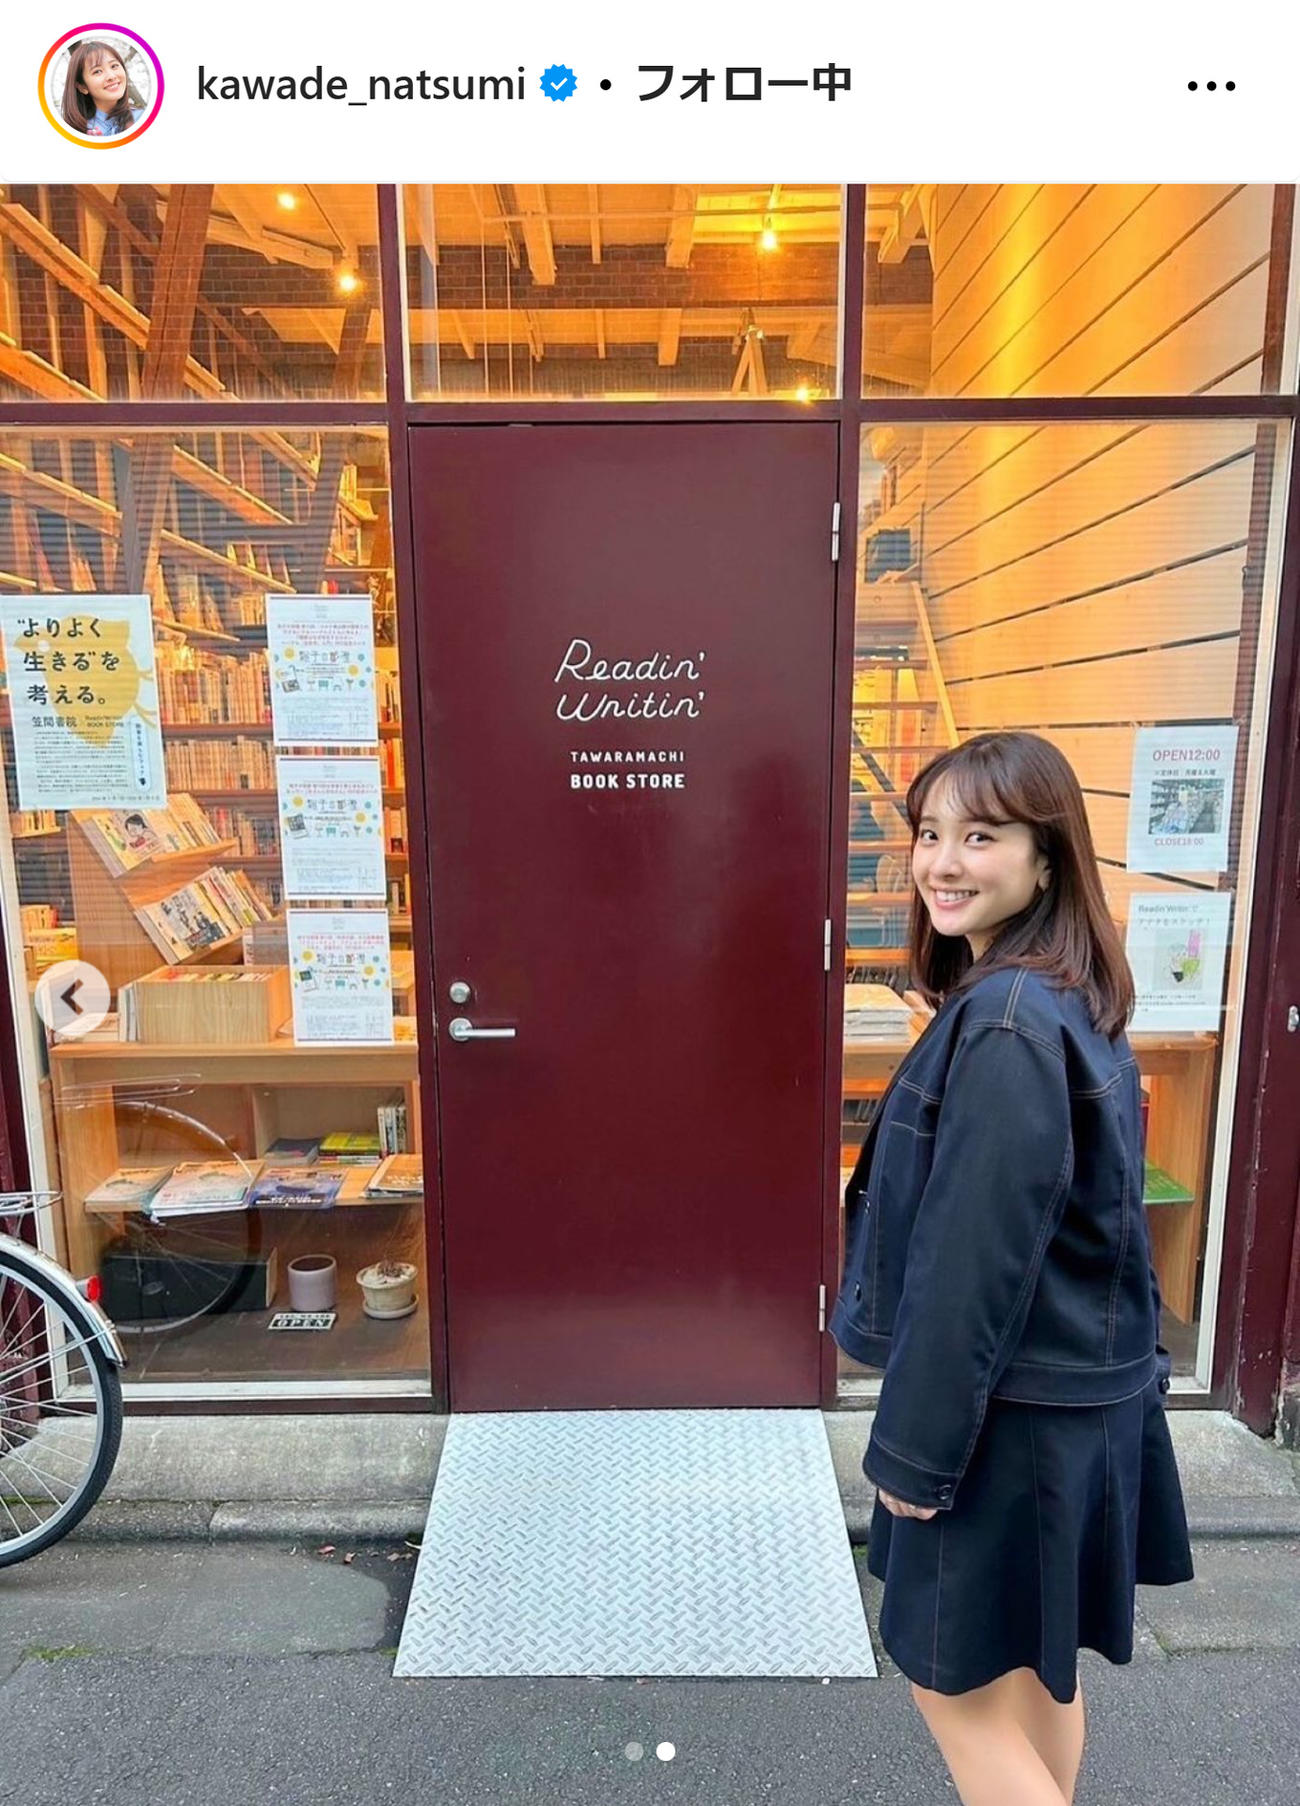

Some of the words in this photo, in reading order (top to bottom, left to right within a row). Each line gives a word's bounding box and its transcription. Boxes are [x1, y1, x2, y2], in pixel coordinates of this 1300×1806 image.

[27, 685, 105, 705] 考える。
[570, 751, 684, 762] TAWARAMACHI
[570, 774, 619, 789] BOOK
[626, 774, 685, 789] STORE
[277, 1319, 327, 1328] OPEN
